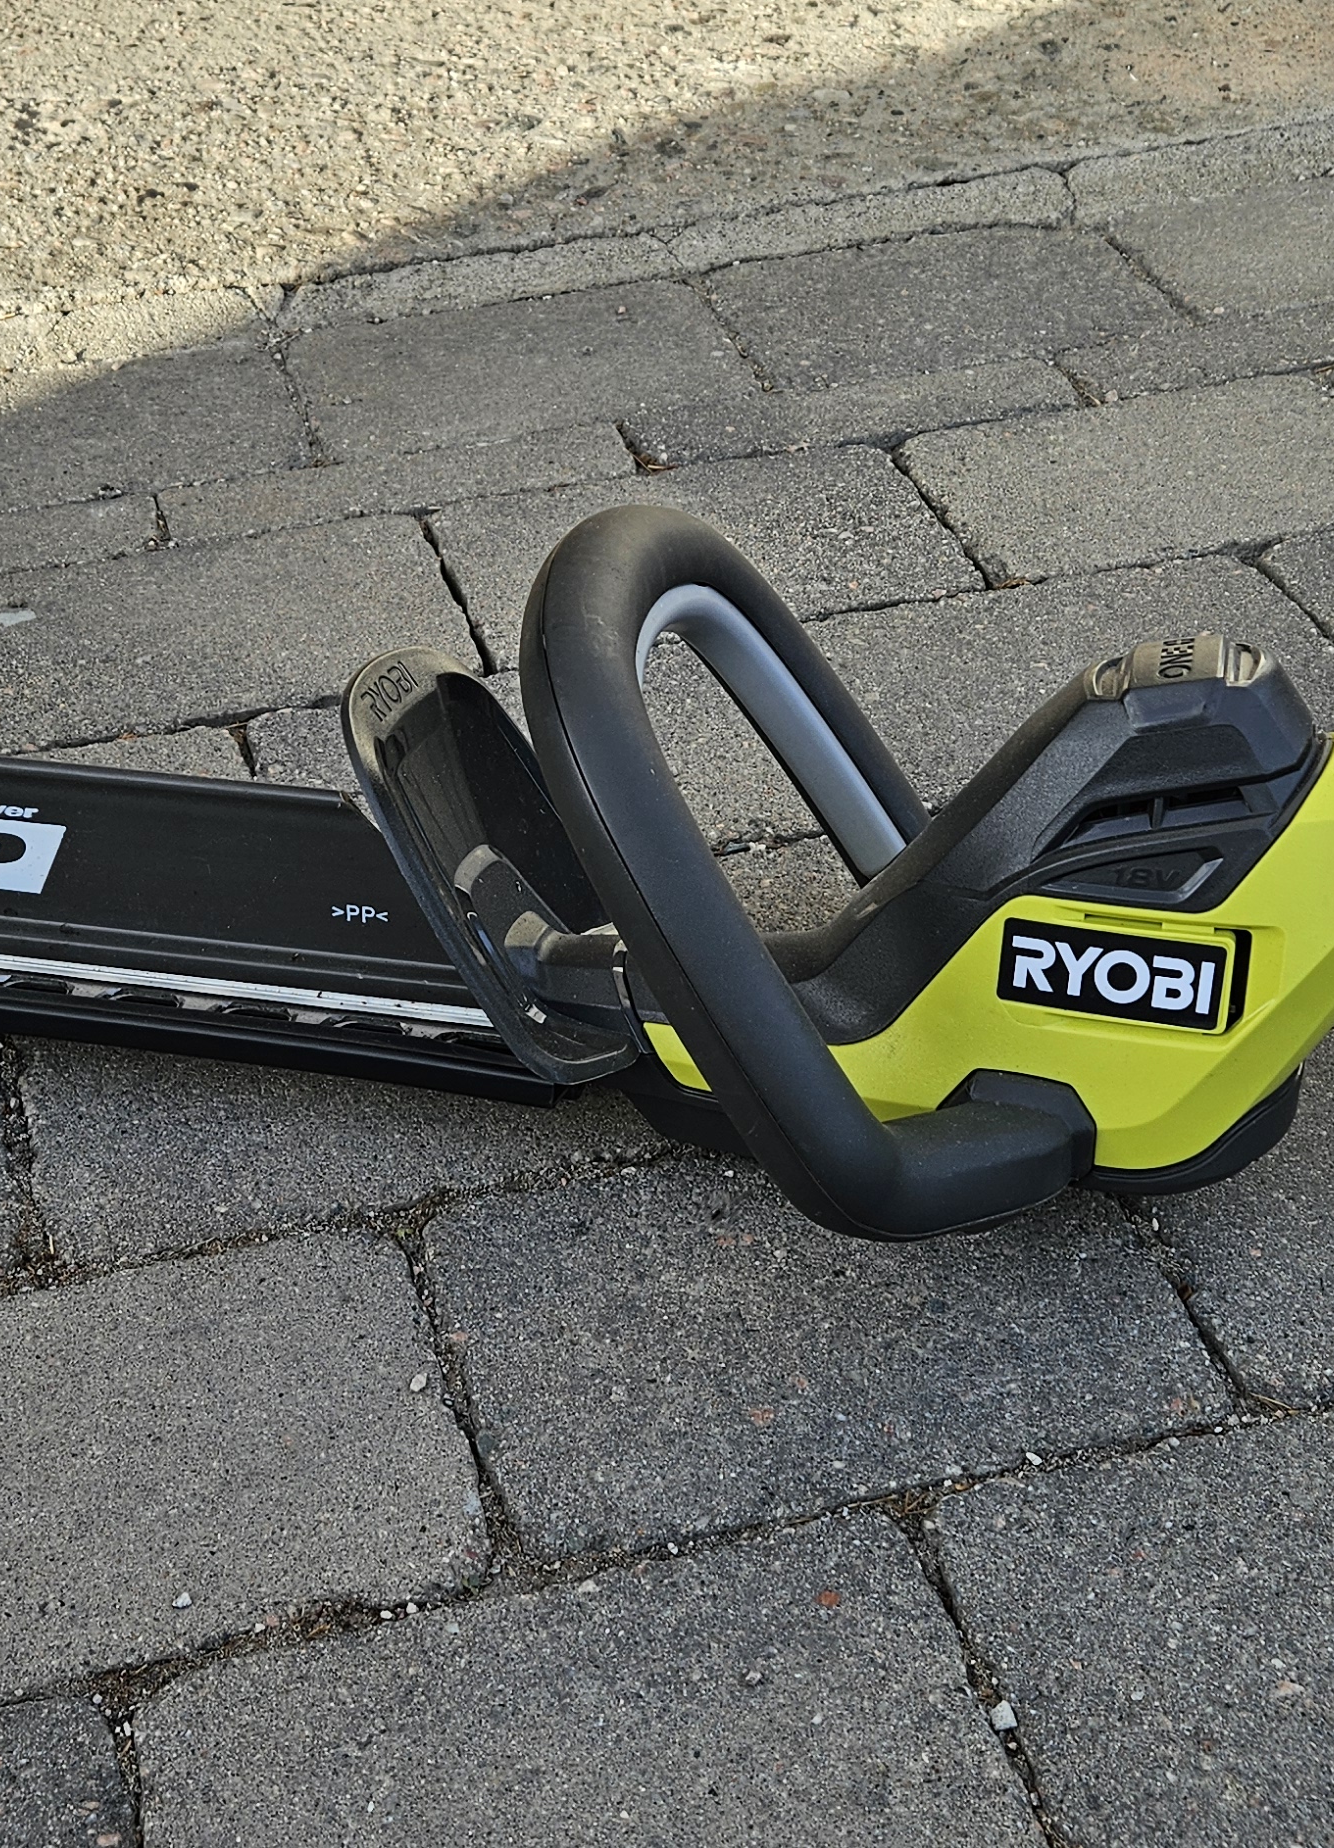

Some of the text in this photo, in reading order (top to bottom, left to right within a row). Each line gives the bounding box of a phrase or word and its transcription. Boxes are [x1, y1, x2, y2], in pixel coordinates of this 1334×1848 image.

[360, 660, 419, 722] RYOBI
[1114, 864, 1181, 889] 18V
[1012, 935, 1216, 1015] RYOBI
